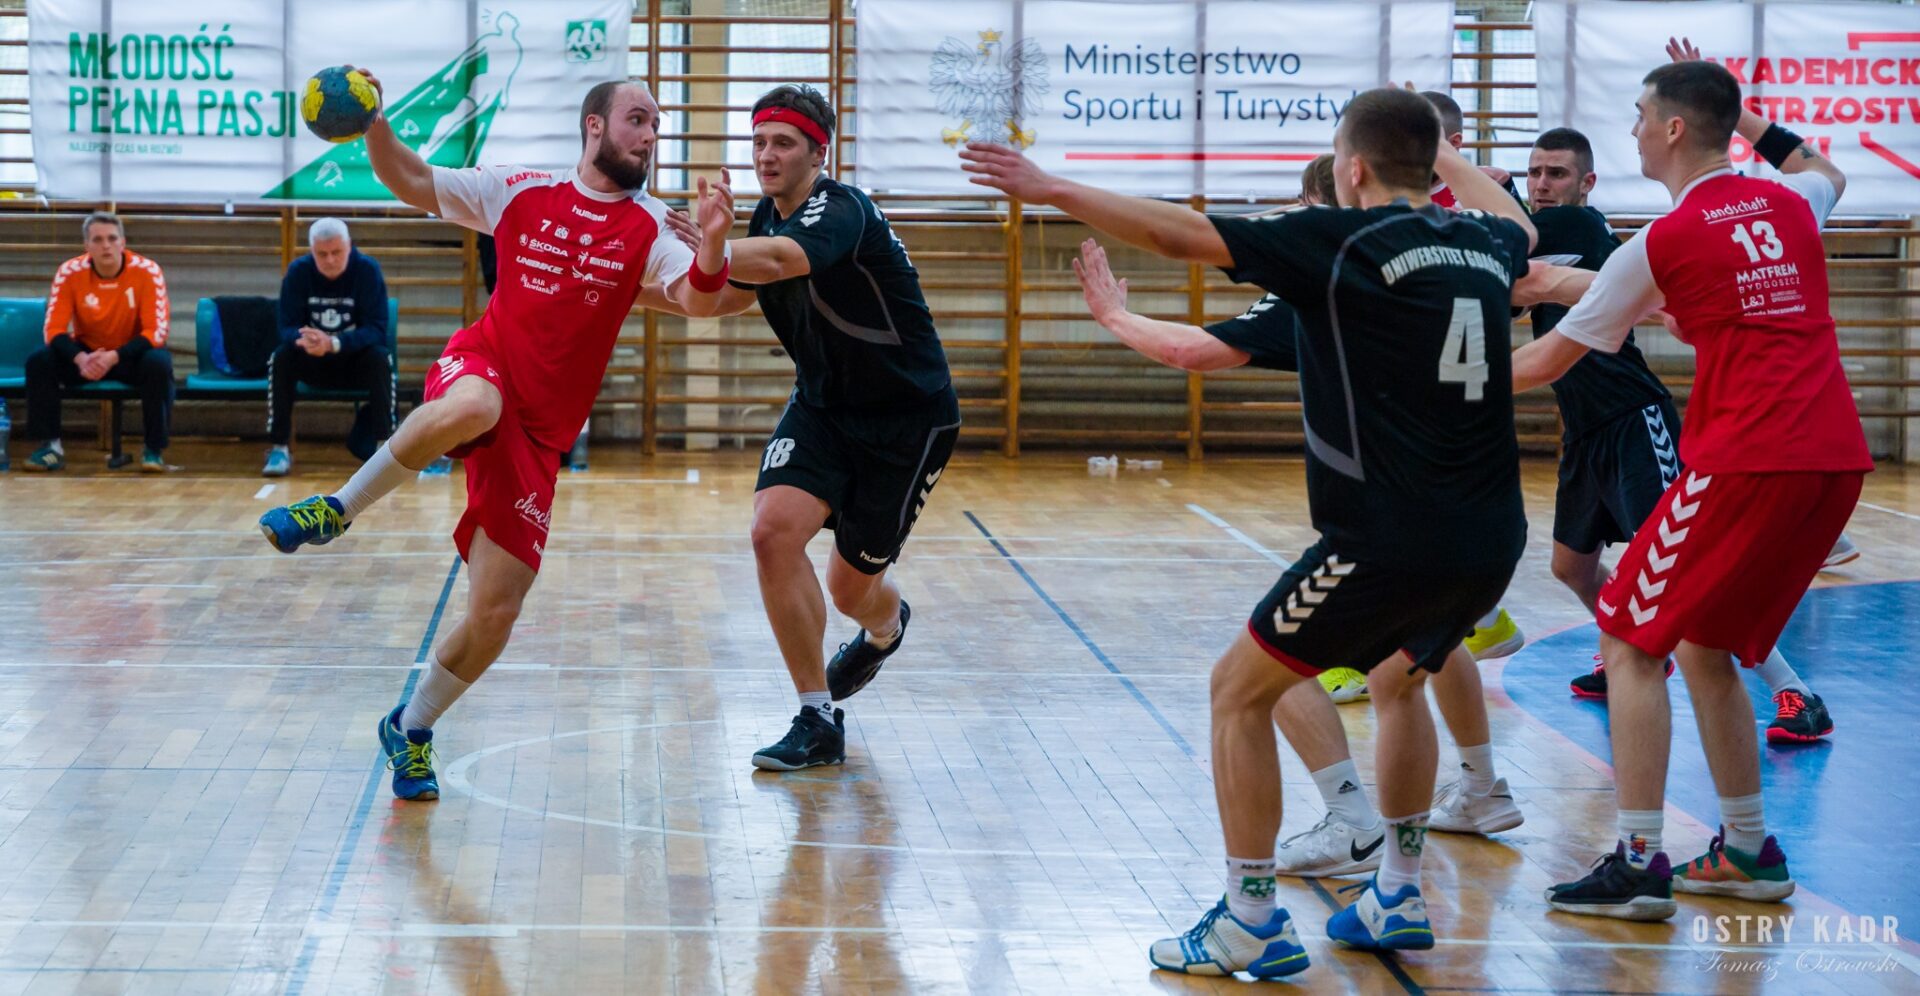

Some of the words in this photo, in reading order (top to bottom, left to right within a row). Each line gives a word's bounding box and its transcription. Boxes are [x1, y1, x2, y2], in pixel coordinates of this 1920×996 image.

[68, 24, 234, 80] MŁODOŚĆ
[1065, 44, 1301, 74] Ministerstwo
[1704, 57, 1920, 85] KADEMICK
[68, 86, 184, 135] PEŁNA
[198, 89, 297, 138] PASJI
[1063, 89, 1181, 126] Sportu
[1196, 90, 1203, 120] i
[1215, 89, 1357, 128] Turysty
[540, 219, 552, 233] 7
[572, 204, 607, 222] hummel
[529, 238, 568, 257] ŠKODA
[1731, 220, 1784, 263] 13
[1381, 245, 1466, 285] UNIWERSYTET
[1736, 262, 1798, 284] MATFREM
[124, 287, 135, 308] 1
[1739, 277, 1800, 293] BYDGOSZCZ
[1741, 294, 1765, 309] L&J
[1438, 297, 1489, 401] 4
[762, 438, 795, 472] 18
